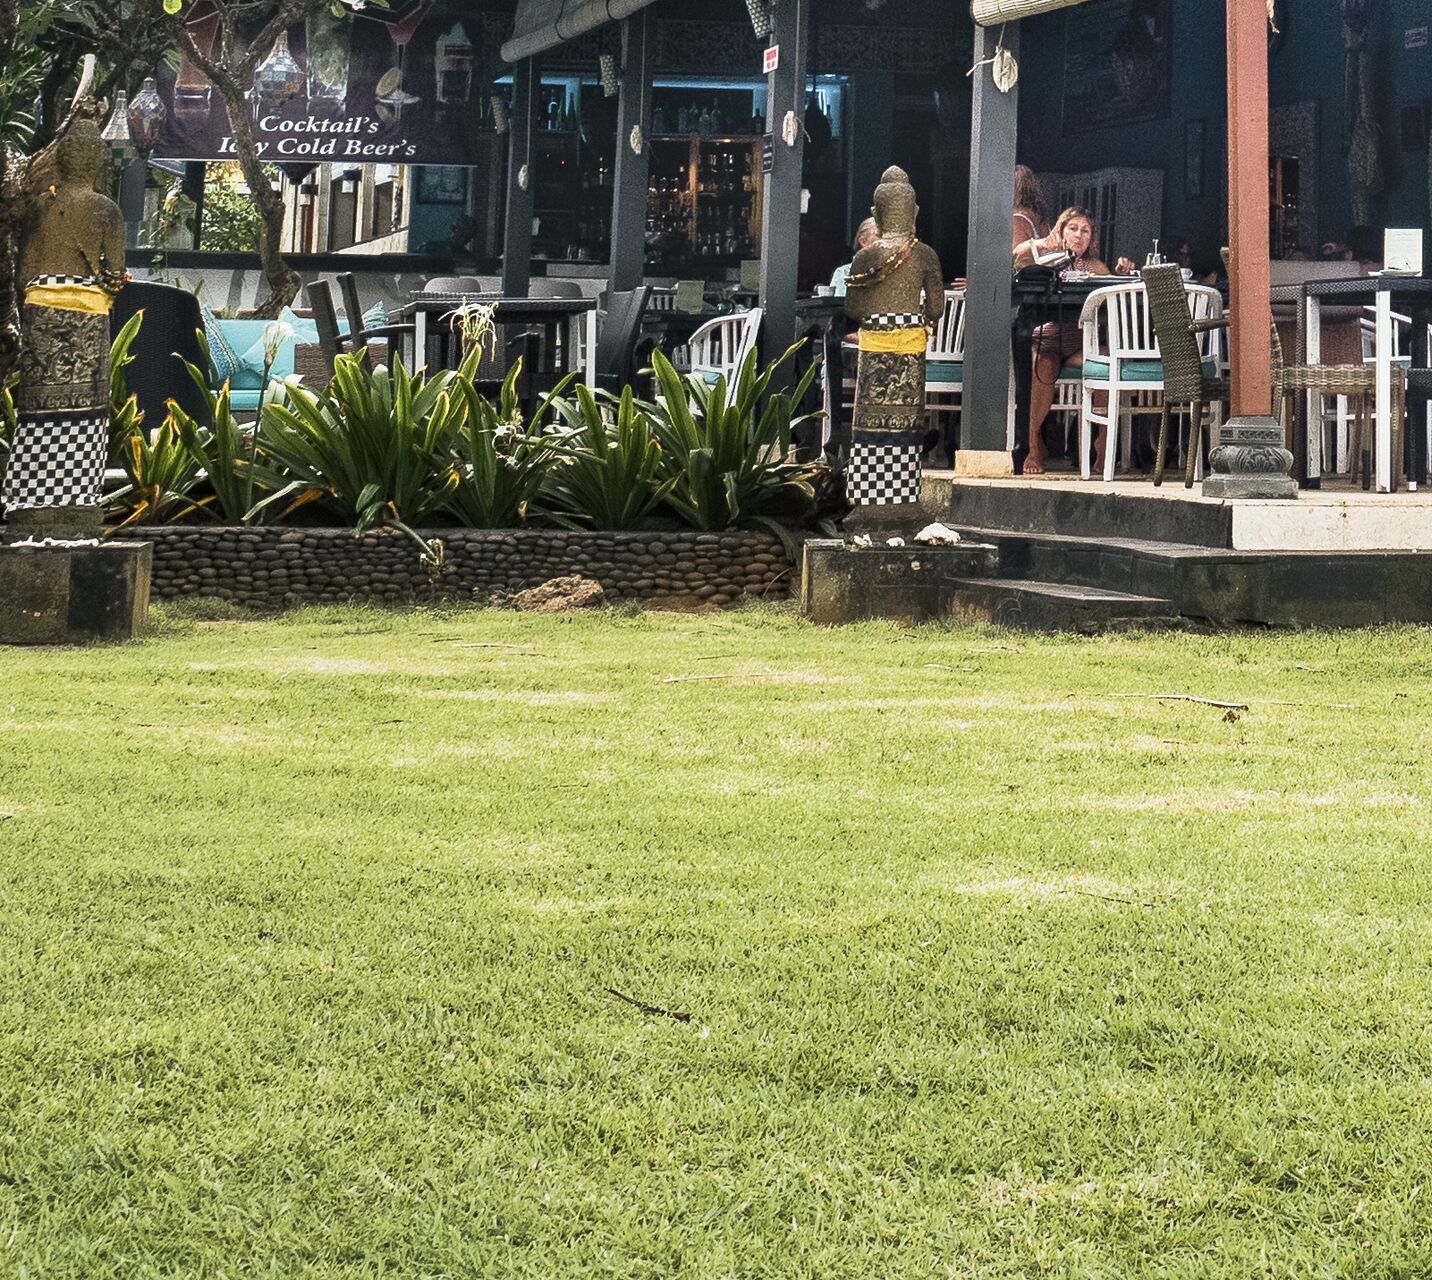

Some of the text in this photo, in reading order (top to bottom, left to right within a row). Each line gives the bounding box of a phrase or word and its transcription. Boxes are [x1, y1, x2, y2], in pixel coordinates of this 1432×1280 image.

[259, 115, 379, 134] Cocktail's
[277, 138, 337, 155] Cold
[343, 139, 417, 156] Beer's
